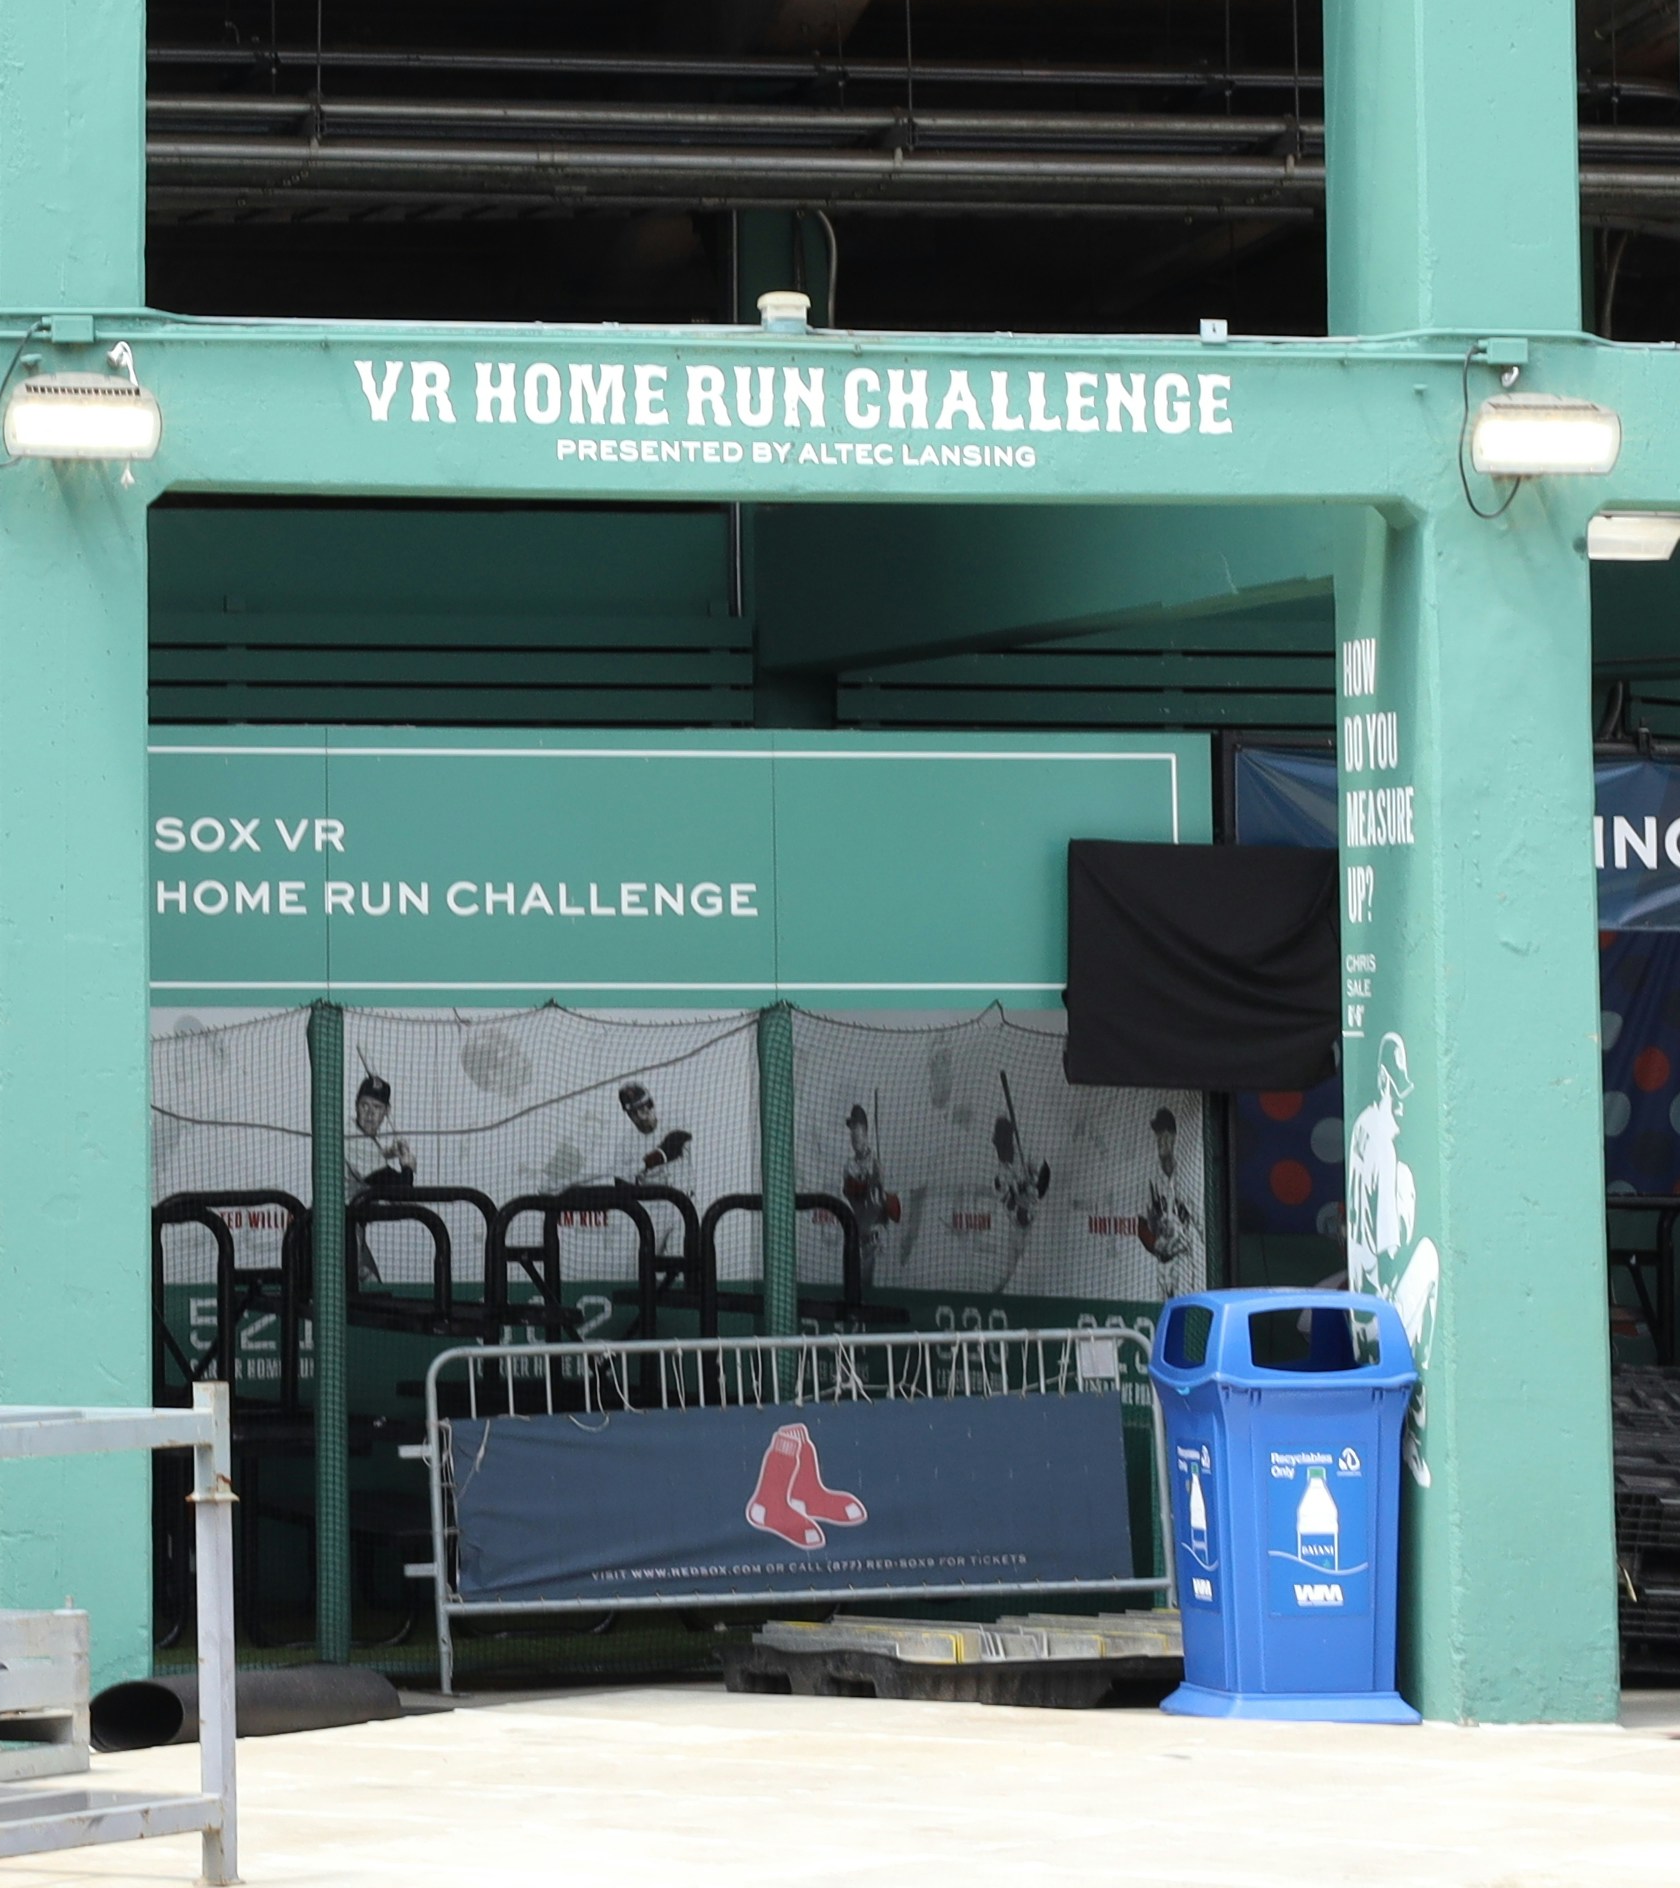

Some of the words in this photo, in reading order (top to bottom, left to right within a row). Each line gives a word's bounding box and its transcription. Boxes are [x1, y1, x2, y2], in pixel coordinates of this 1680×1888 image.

[354, 359, 457, 426] VR
[474, 361, 671, 429] HOME
[687, 364, 826, 430] RUN
[843, 367, 1234, 436] CHALLENGE
[555, 438, 744, 464] PRESENTED
[752, 440, 792, 464] BY
[797, 441, 894, 467] ALTEC
[901, 443, 1038, 470] LANSING
[1343, 638, 1377, 695] HOW
[1344, 713, 1364, 771] DO
[1364, 711, 1398, 770] YOU
[154, 816, 261, 855] SOX
[274, 817, 348, 855] VR
[1346, 785, 1415, 848] MEASURE
[154, 880, 311, 918] HOME
[323, 880, 431, 918] RUN
[445, 880, 761, 919] CHALLENGE
[1347, 866, 1375, 925] UP?
[1346, 953, 1377, 974] CHRIS
[1346, 978, 1372, 998] SALE
[248, 1211, 295, 1229] WILLI
[591, 1569, 626, 1581] VISIT
[765, 1562, 784, 1574] OR
[789, 1561, 824, 1573] CALL
[1294, 1584, 1344, 1602] WM
